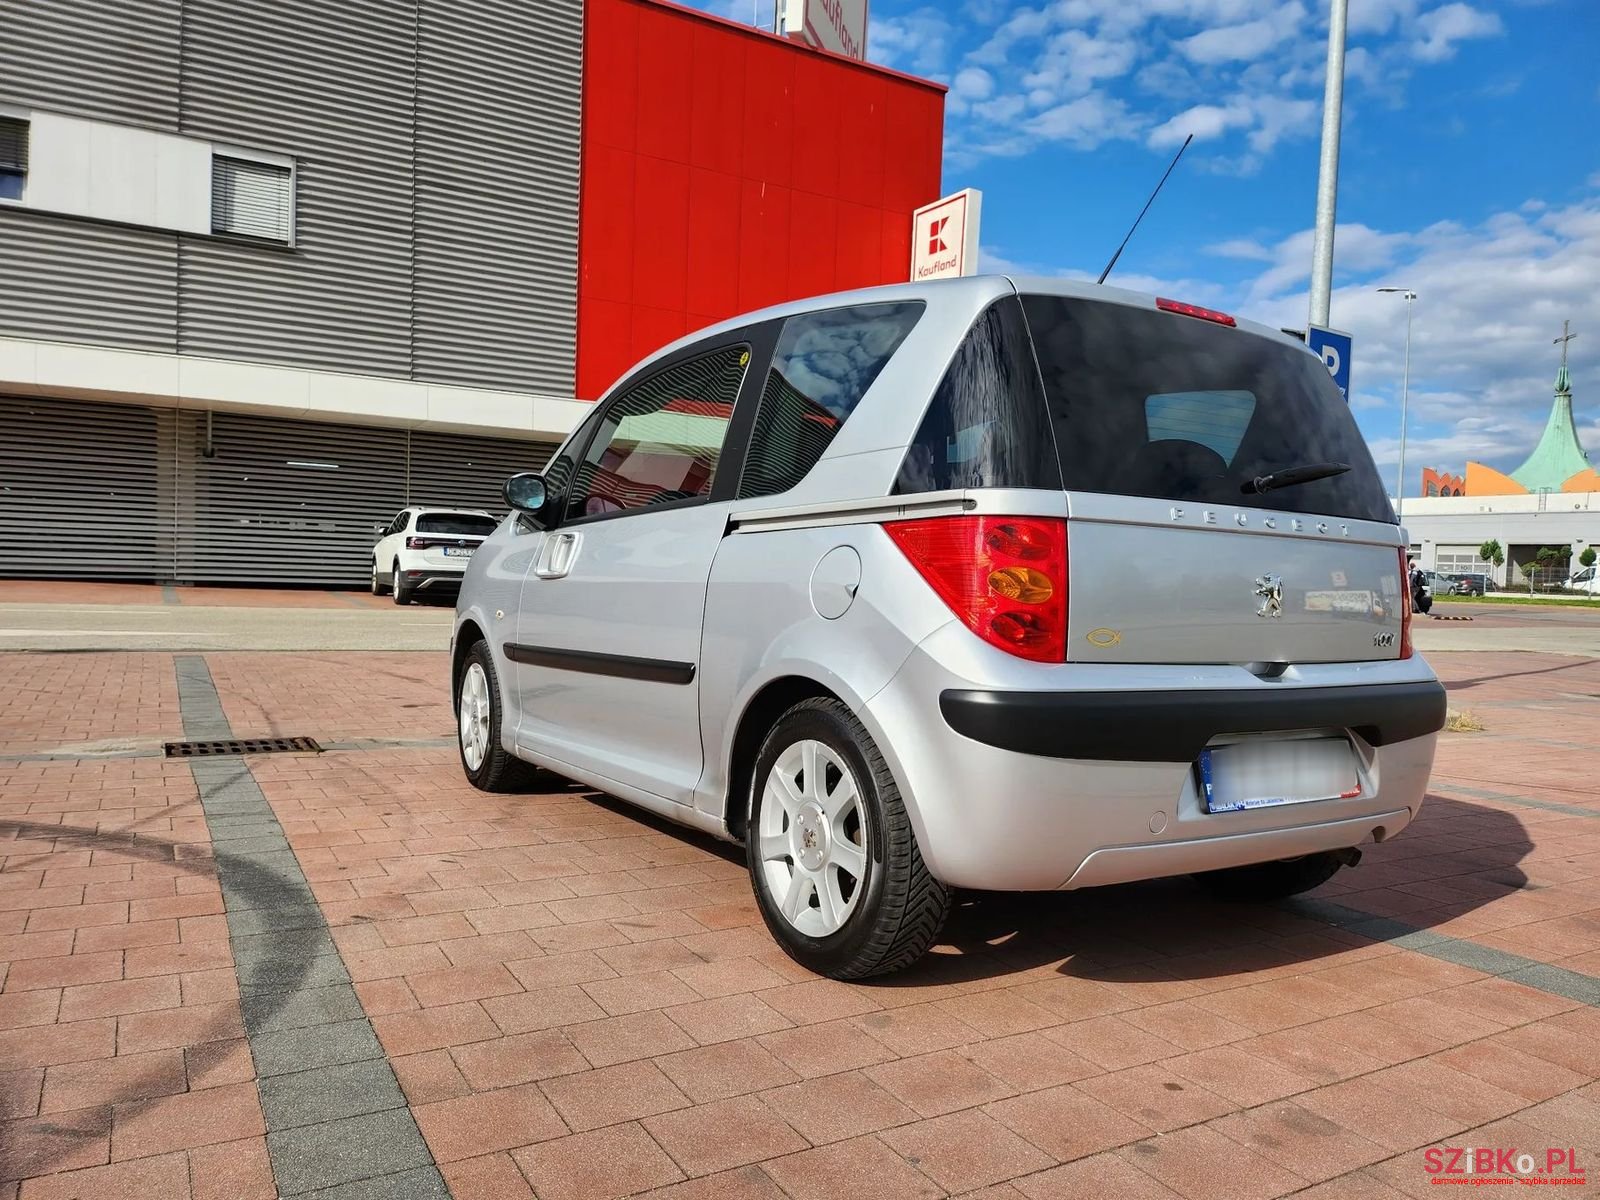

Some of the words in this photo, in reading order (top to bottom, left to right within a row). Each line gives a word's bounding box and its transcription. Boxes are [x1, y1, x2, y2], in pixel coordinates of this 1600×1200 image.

[822, 0, 859, 60] aufland
[918, 254, 957, 278] Kaufland
[1170, 507, 1348, 536] PEUGEOT
